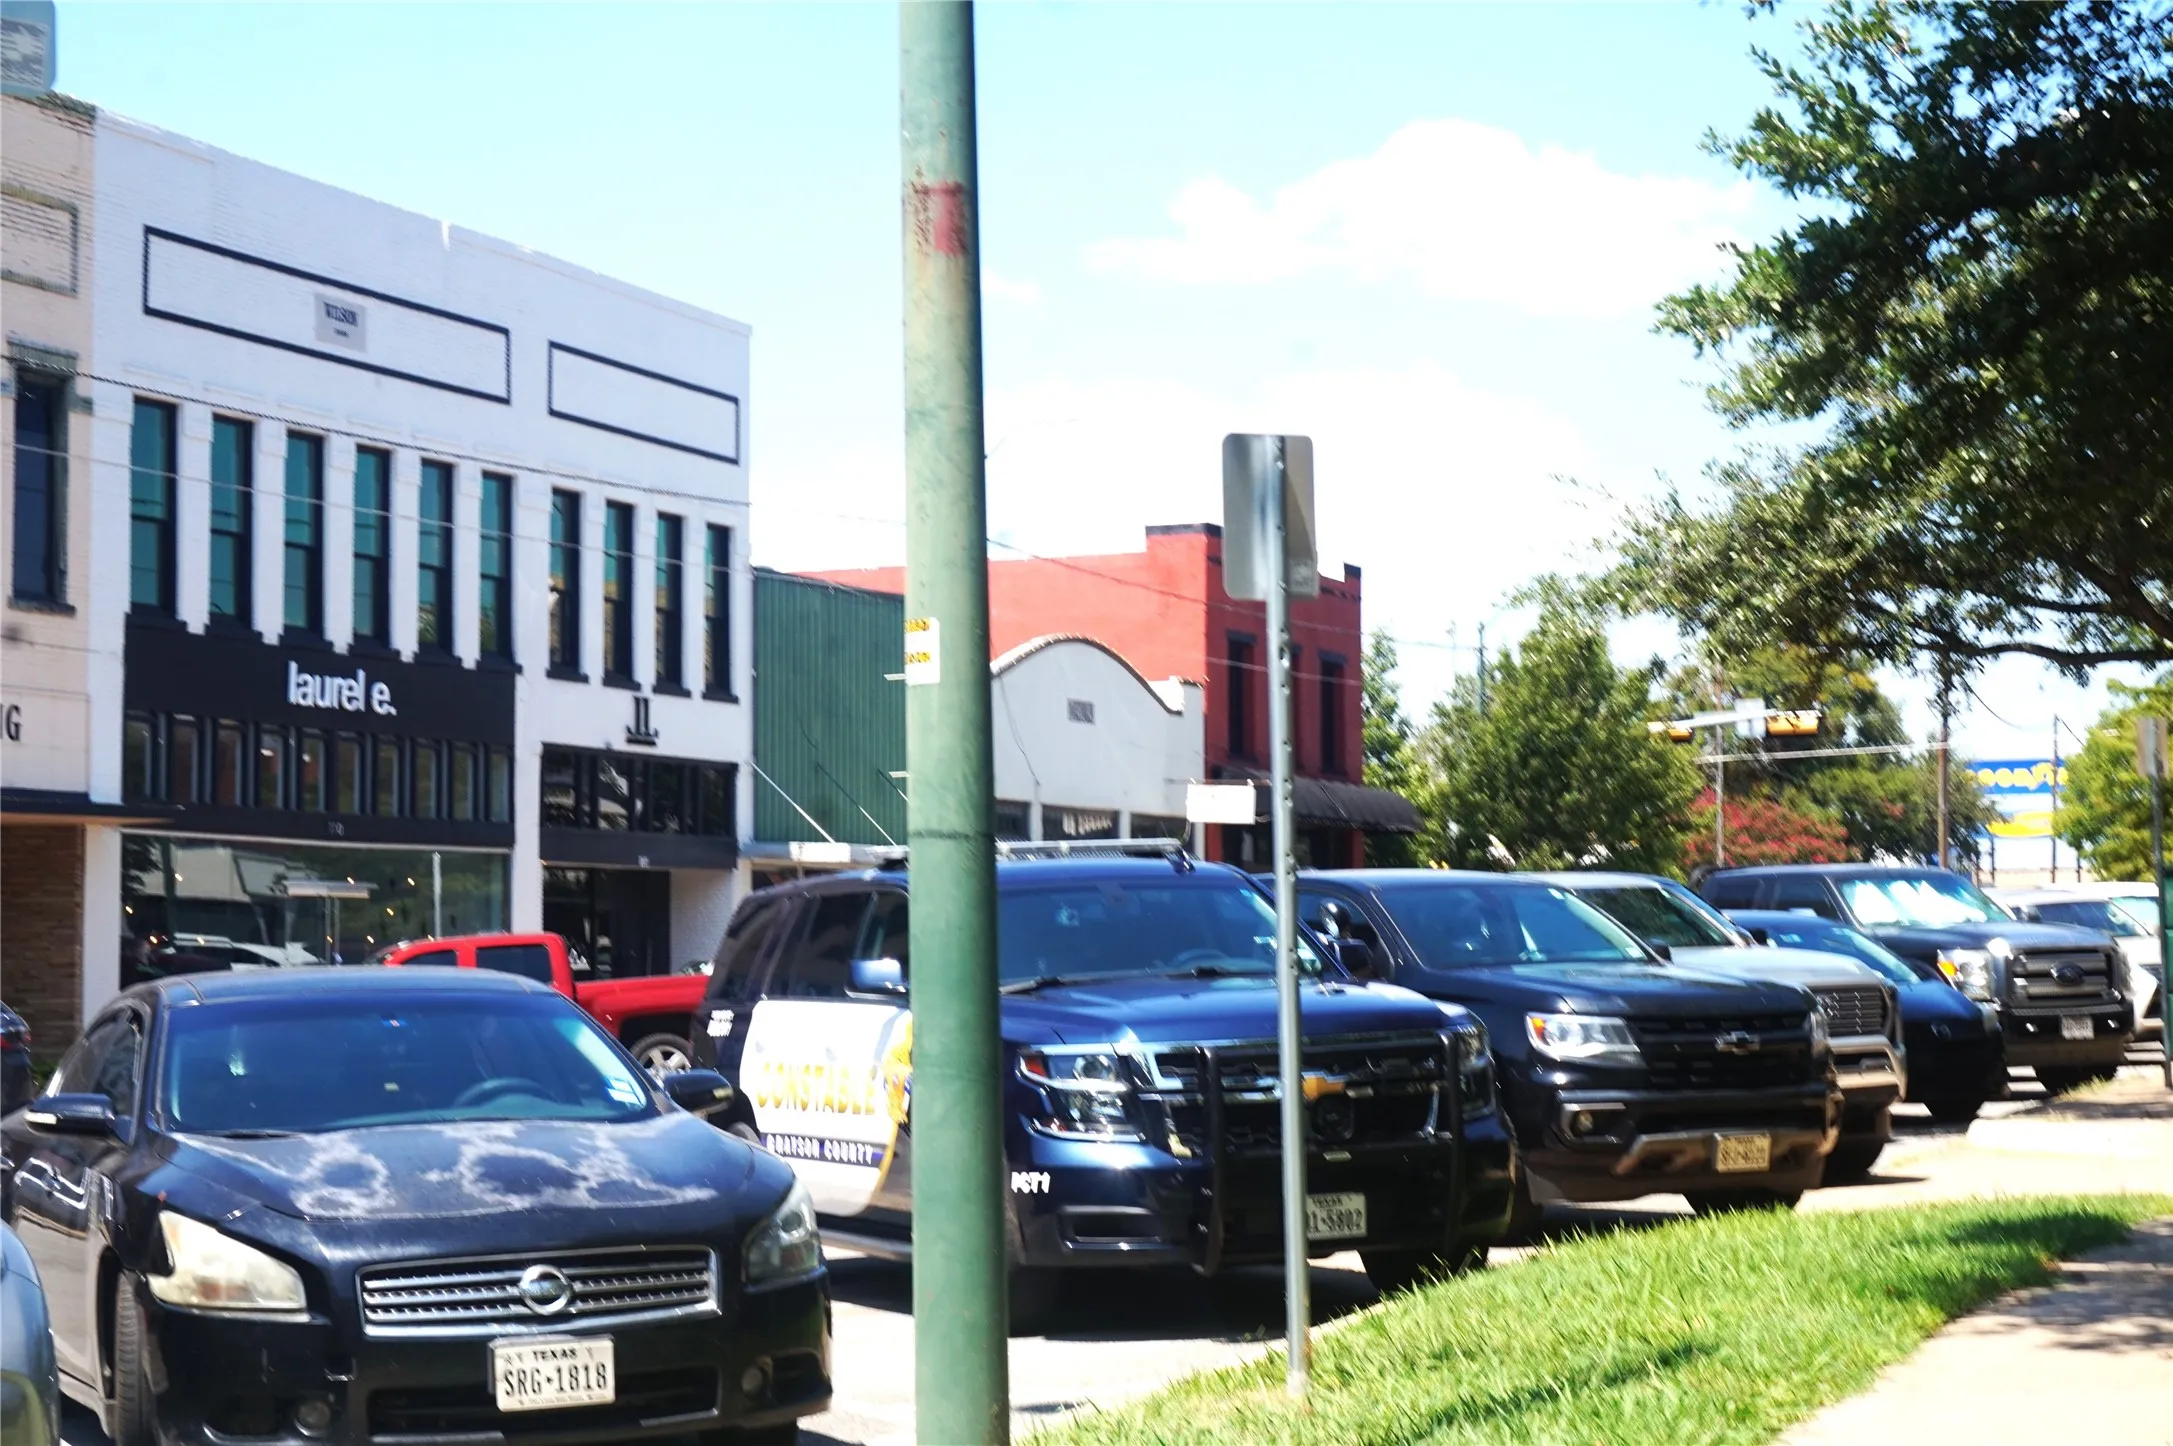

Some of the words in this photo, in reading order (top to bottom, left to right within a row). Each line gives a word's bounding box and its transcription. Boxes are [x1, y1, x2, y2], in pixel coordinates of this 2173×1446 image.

[288, 660, 366, 712] laurel
[757, 1061, 875, 1115] CONSTABLE
[766, 1133, 820, 1159] GRAYSON
[823, 1139, 873, 1165] COUNTY
[532, 1348, 577, 1362] TEXAS
